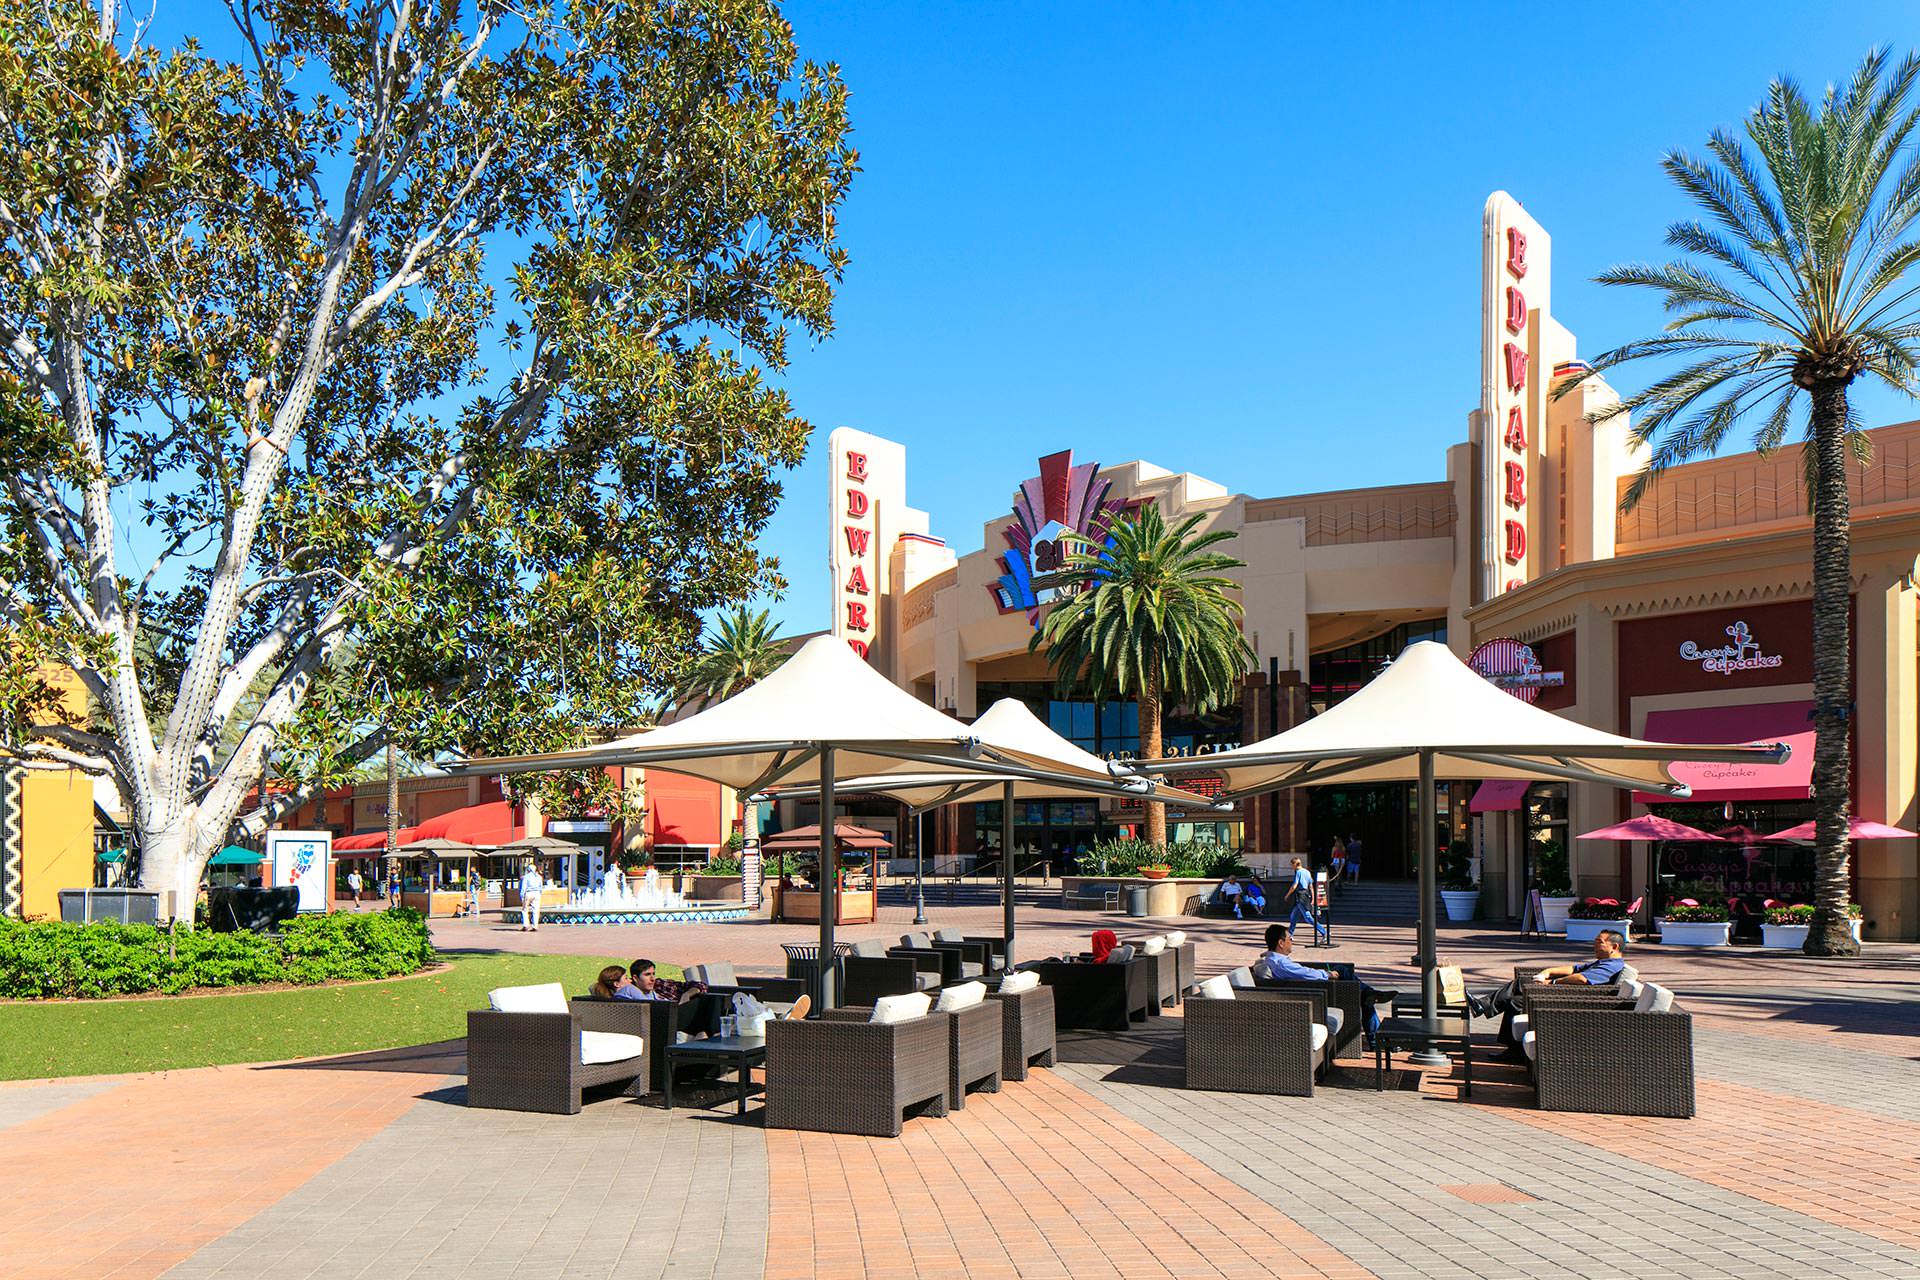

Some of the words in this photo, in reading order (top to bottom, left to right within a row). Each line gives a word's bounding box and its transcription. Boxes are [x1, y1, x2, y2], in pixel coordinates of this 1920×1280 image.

[1504, 226, 1529, 591] EDWARD
[1680, 640, 1738, 666] Casey's
[1702, 650, 1783, 675] Cupcakes
[1703, 767, 1757, 779] Cupcakes
